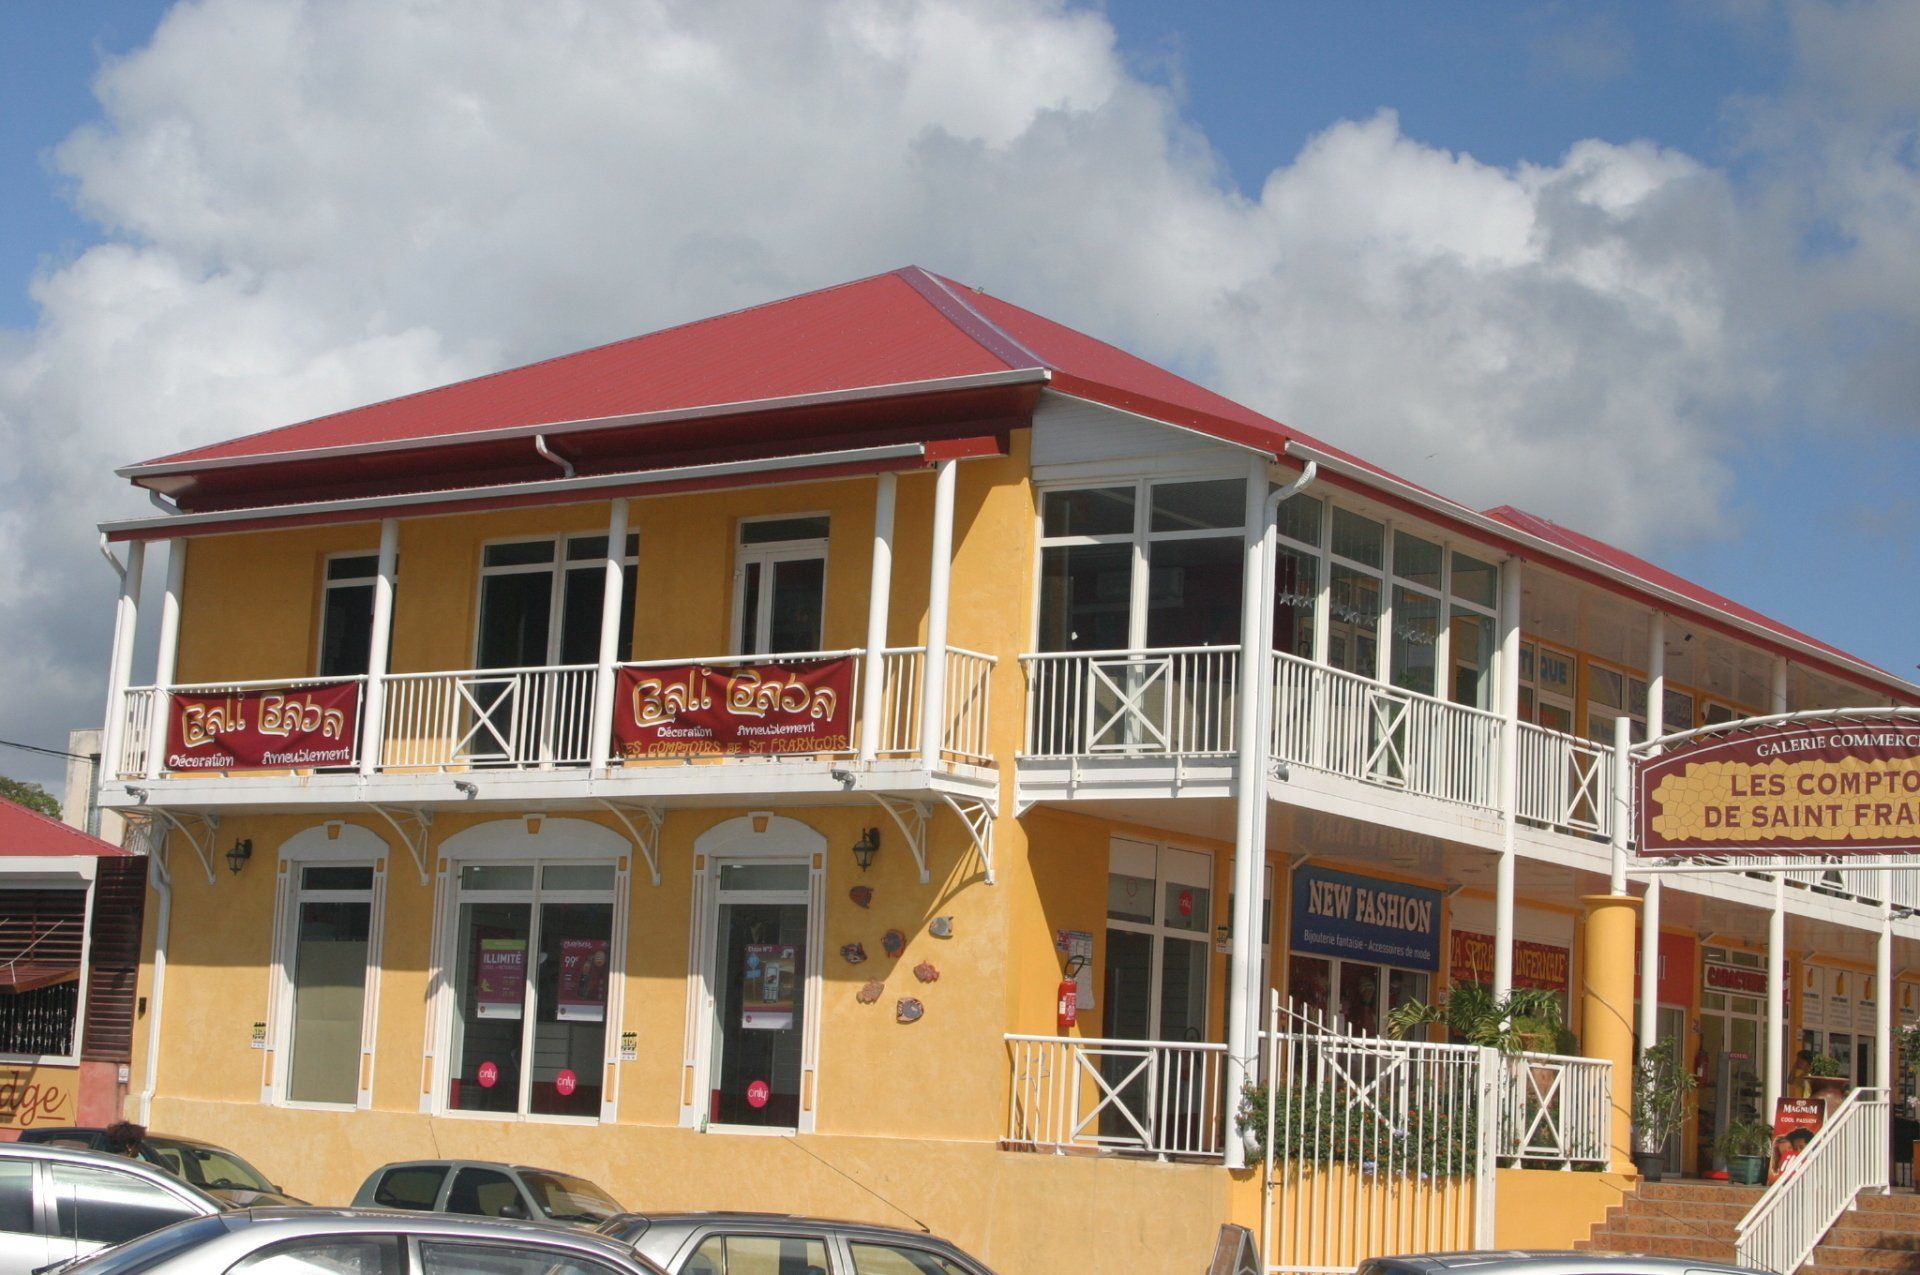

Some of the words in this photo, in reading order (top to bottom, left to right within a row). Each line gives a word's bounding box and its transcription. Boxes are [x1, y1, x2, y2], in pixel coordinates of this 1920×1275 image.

[633, 667, 712, 728] Bali
[726, 669, 837, 722] Baba
[182, 692, 246, 748] Bali
[258, 692, 344, 740] Baba
[657, 725, 713, 738] Décoration
[737, 722, 815, 736] Ameublement
[1756, 736, 1826, 756] GALERIE
[169, 752, 235, 768] Décoration
[262, 746, 350, 765] Ameublement
[1731, 773, 1786, 797] LES
[1796, 770, 1920, 795] COMPTO
[1704, 805, 1741, 828] DE
[1752, 804, 1843, 828] SAINT
[1855, 802, 1920, 827] FRA
[1308, 878, 1352, 919] NEW
[1355, 888, 1432, 934] FASHION
[1304, 929, 1335, 945] Bijouterie
[1336, 934, 1363, 949] fantaisie
[1368, 940, 1404, 956] Accessoires
[1405, 945, 1413, 957] de
[1414, 948, 1431, 960] mode
[483, 951, 522, 964] ILLIMITÉ
[479, 1069, 497, 1082] only
[557, 1076, 576, 1090] only
[748, 1088, 768, 1102] only
[1783, 1104, 1817, 1115] MAGNUM
